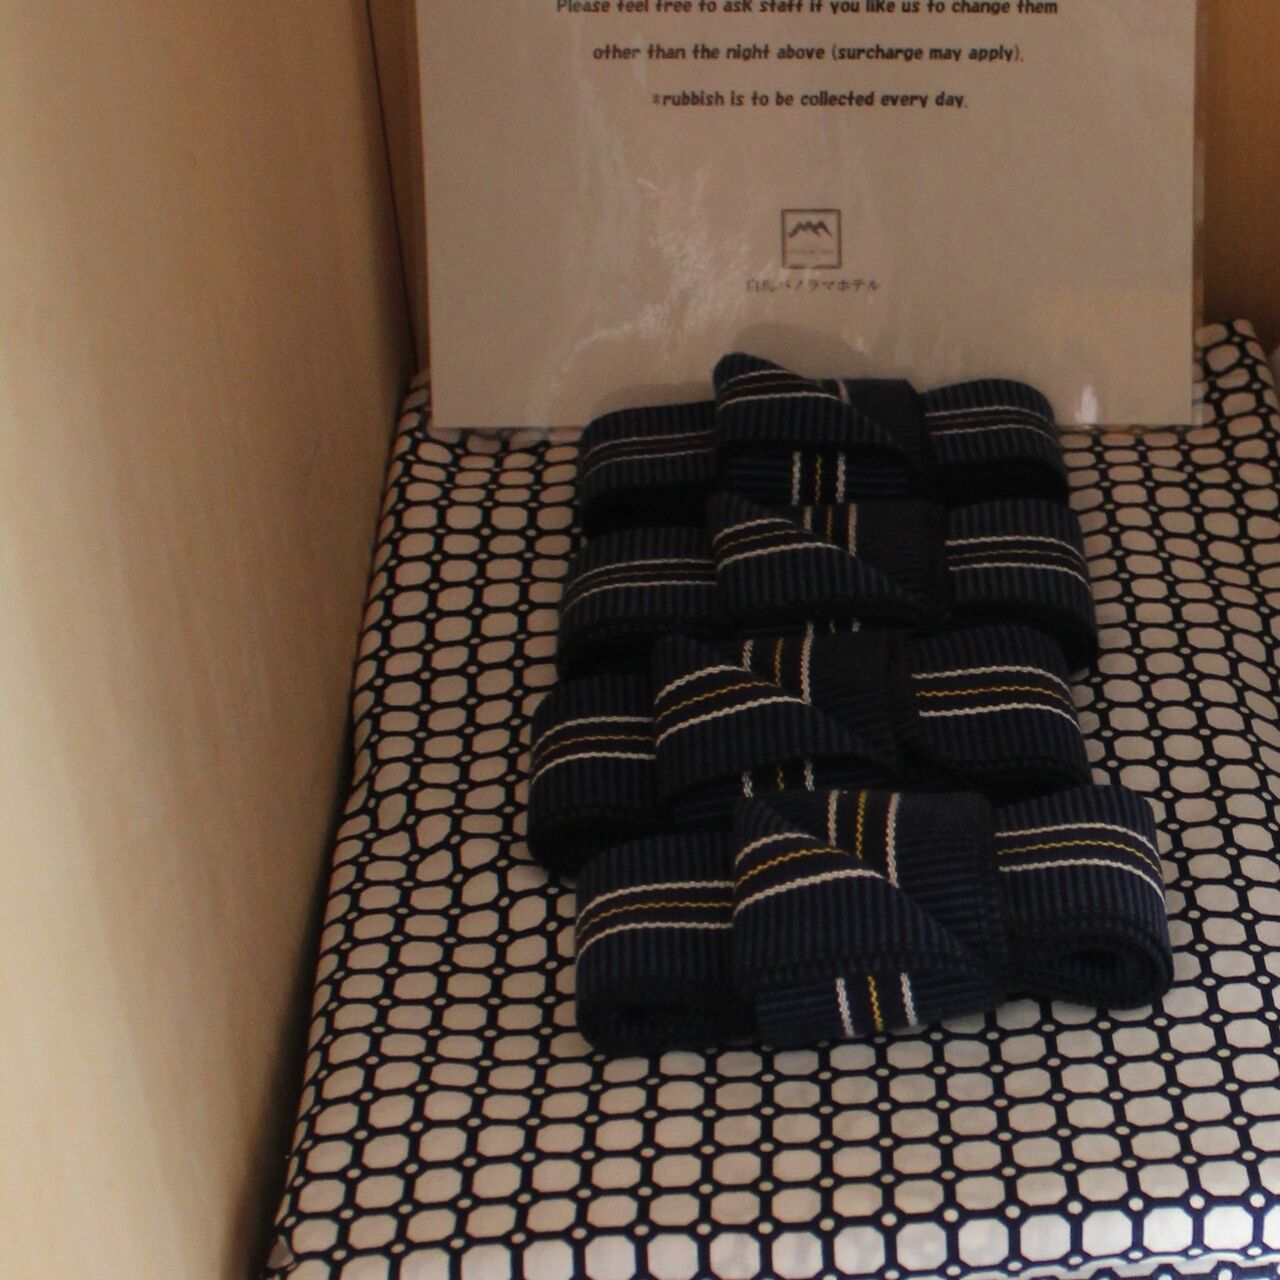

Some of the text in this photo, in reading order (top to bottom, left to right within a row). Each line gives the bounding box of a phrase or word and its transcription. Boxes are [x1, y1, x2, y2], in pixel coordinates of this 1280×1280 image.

[830, 0, 860, 16] you
[902, 1, 921, 15] us
[593, 43, 1024, 63] other than the night above (surcharge may apply).
[730, 90, 745, 107] is
[751, 90, 770, 107] to
[775, 90, 795, 107] be
[800, 90, 875, 107] collected
[880, 94, 929, 109] every
[935, 91, 969, 109] day.
